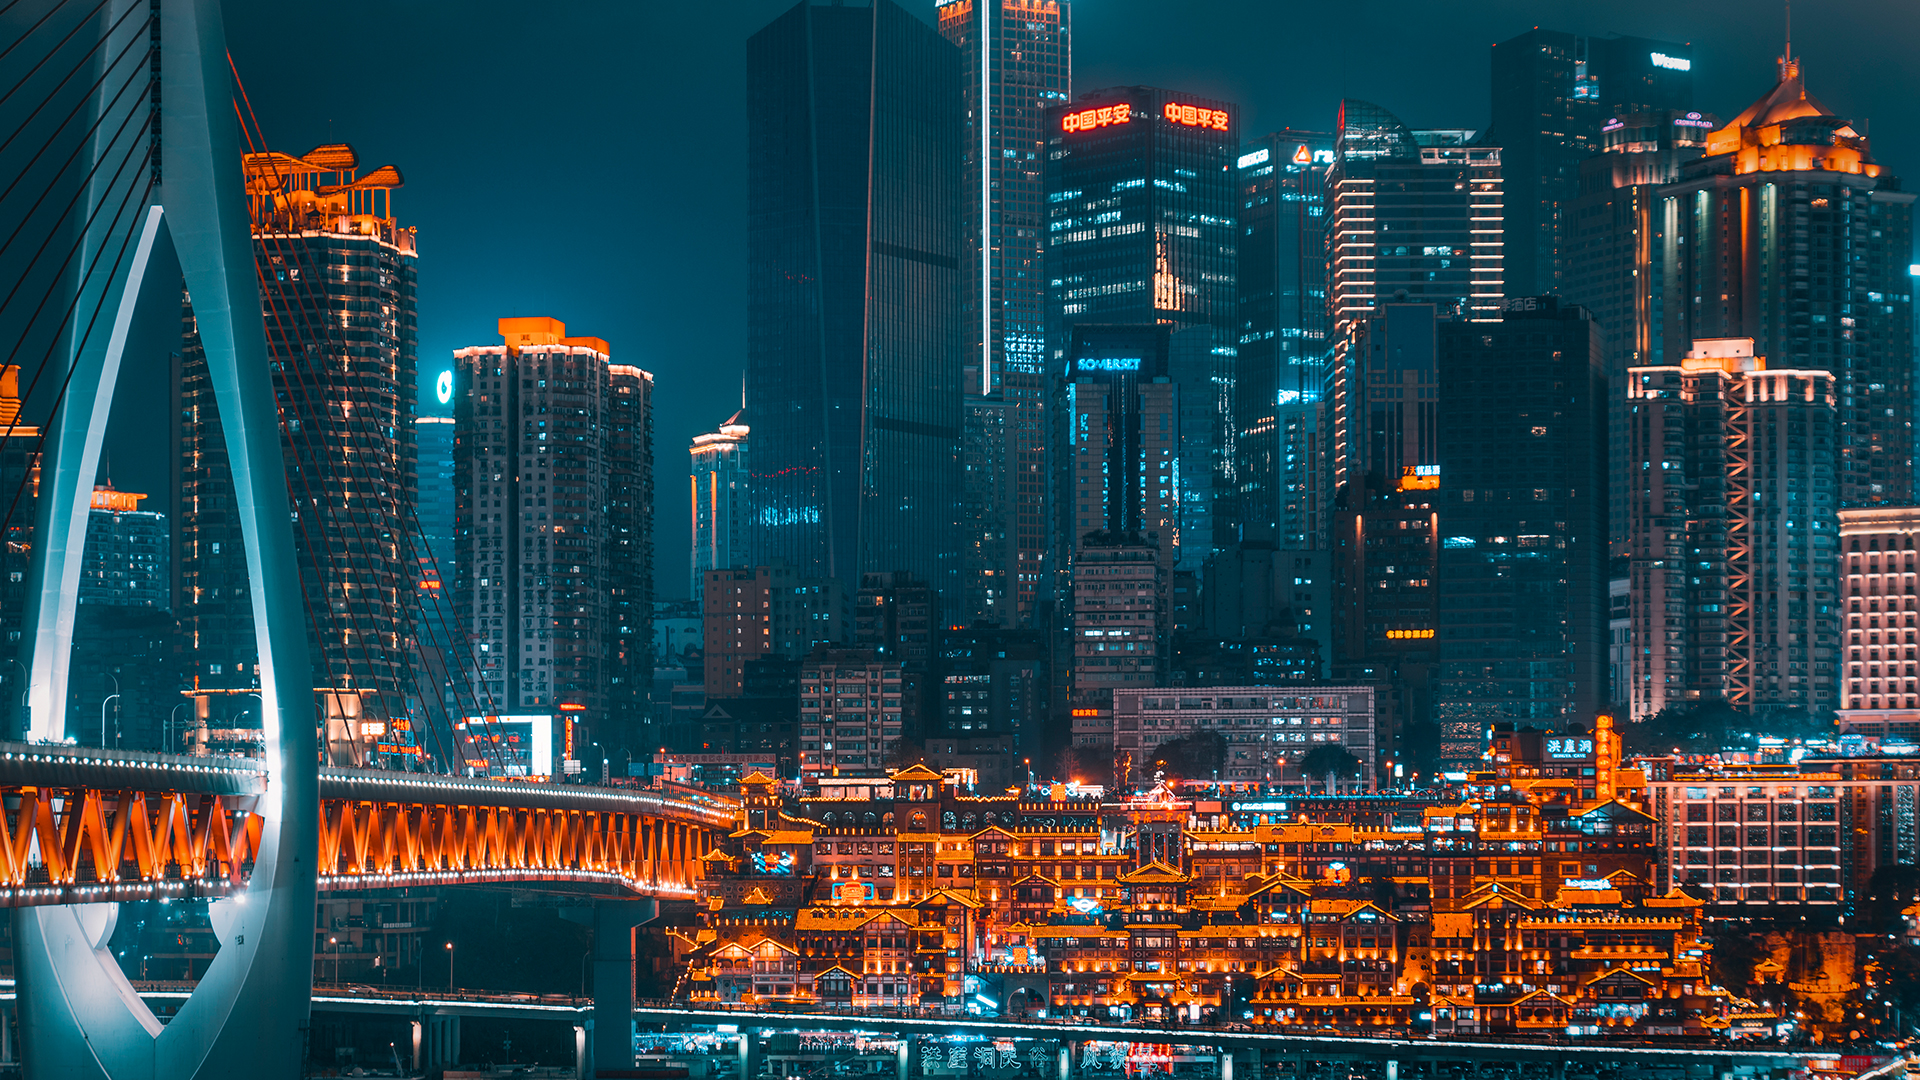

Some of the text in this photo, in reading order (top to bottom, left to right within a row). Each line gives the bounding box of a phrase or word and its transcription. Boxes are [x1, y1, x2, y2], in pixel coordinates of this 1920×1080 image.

[1062, 104, 1131, 133] 中国平安
[1164, 102, 1228, 131] 中国平安
[1674, 119, 1713, 129] CROWNE PLAZA
[1078, 358, 1141, 370] SOMERSET
[1546, 738, 1592, 753] 洪崖洞
